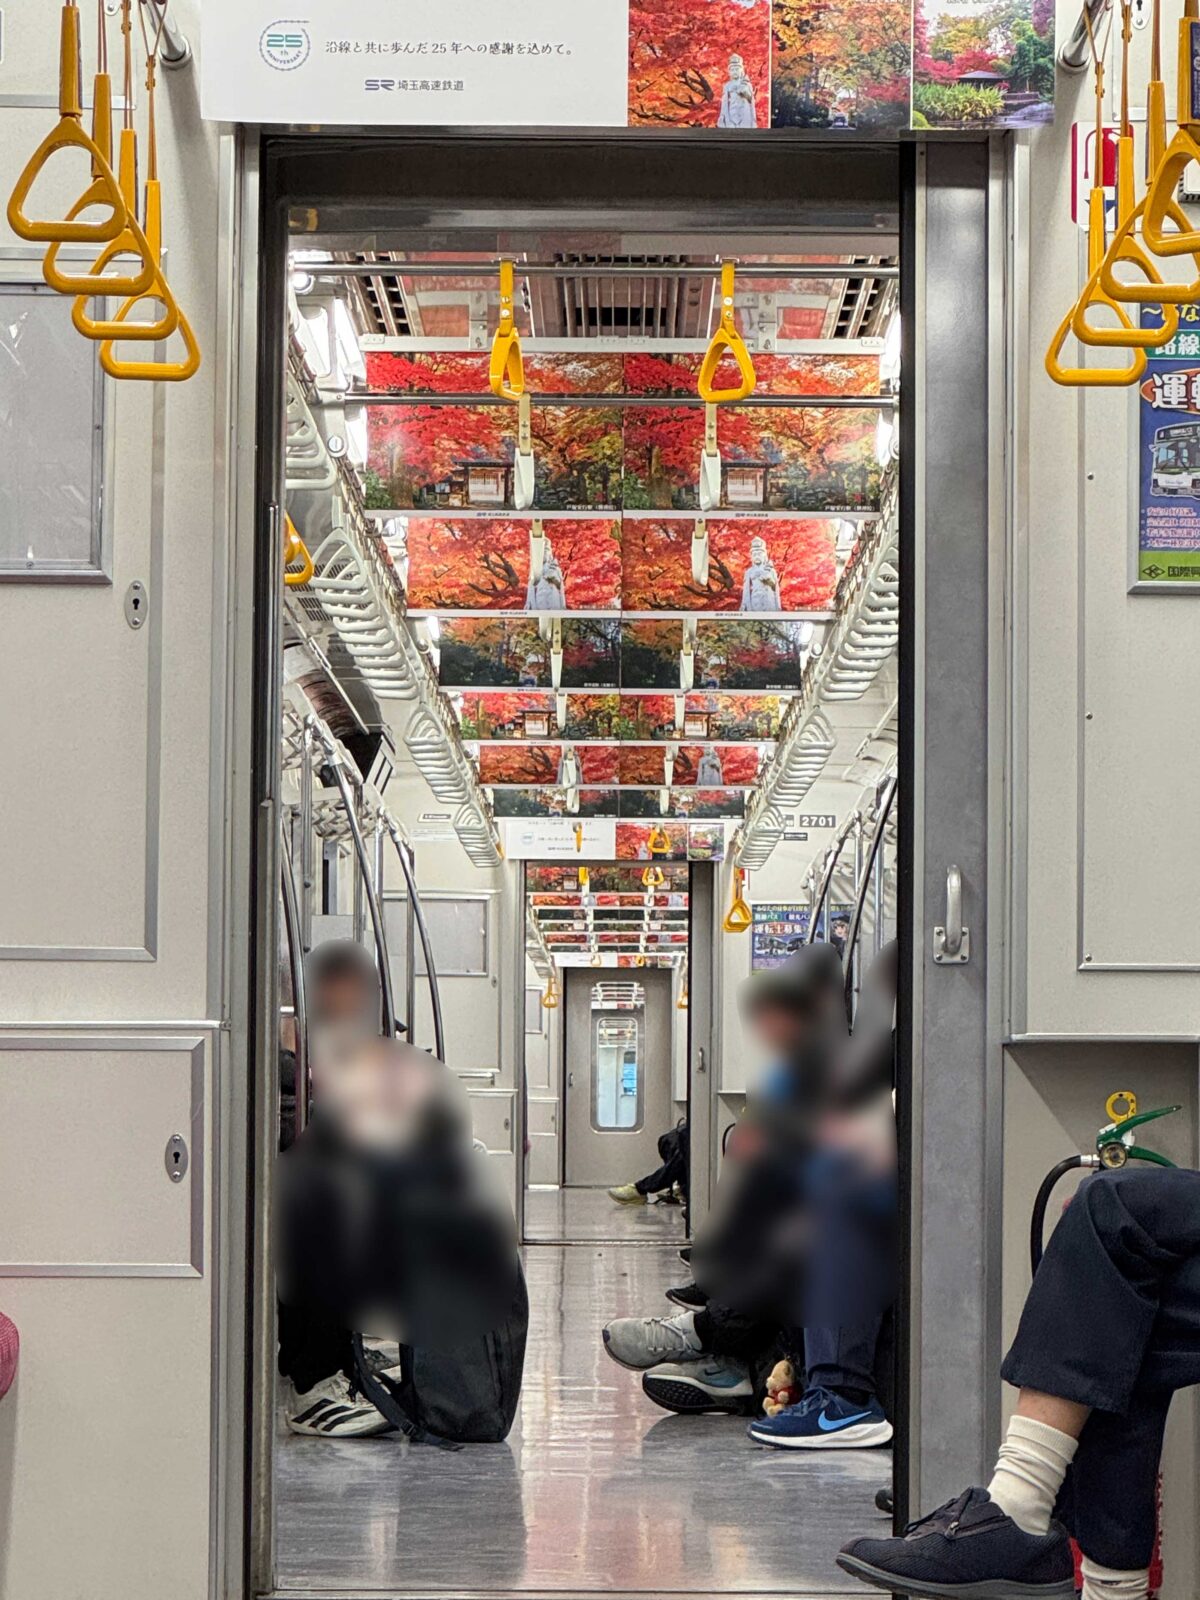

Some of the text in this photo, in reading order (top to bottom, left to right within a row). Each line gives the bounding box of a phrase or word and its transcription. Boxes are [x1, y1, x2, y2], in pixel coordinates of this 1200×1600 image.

[267, 34, 303, 48] 25
[365, 79, 464, 91] SR 埼玉高速鉄道
[801, 816, 833, 827] 2701
